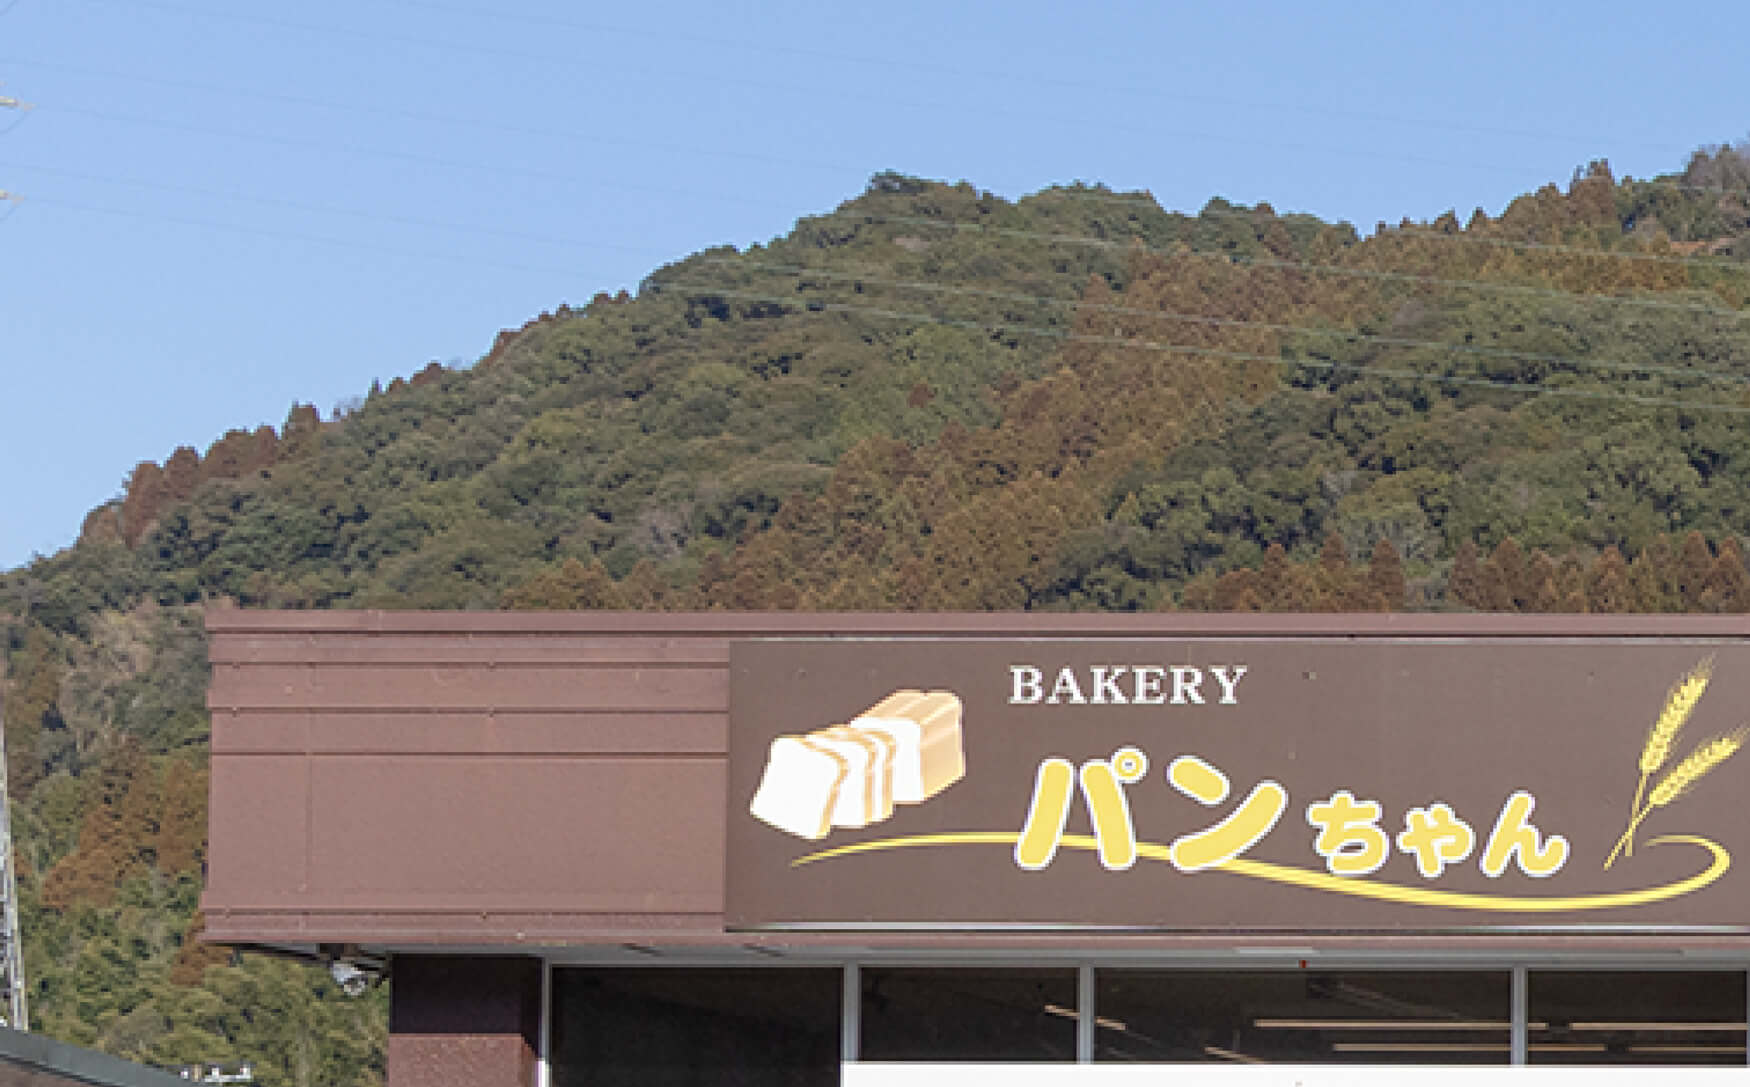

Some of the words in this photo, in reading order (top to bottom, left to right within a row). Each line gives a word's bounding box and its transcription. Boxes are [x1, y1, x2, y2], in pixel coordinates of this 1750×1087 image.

[1009, 666, 1247, 704] BAKERY
[1012, 747, 1570, 879] パンちゃん
